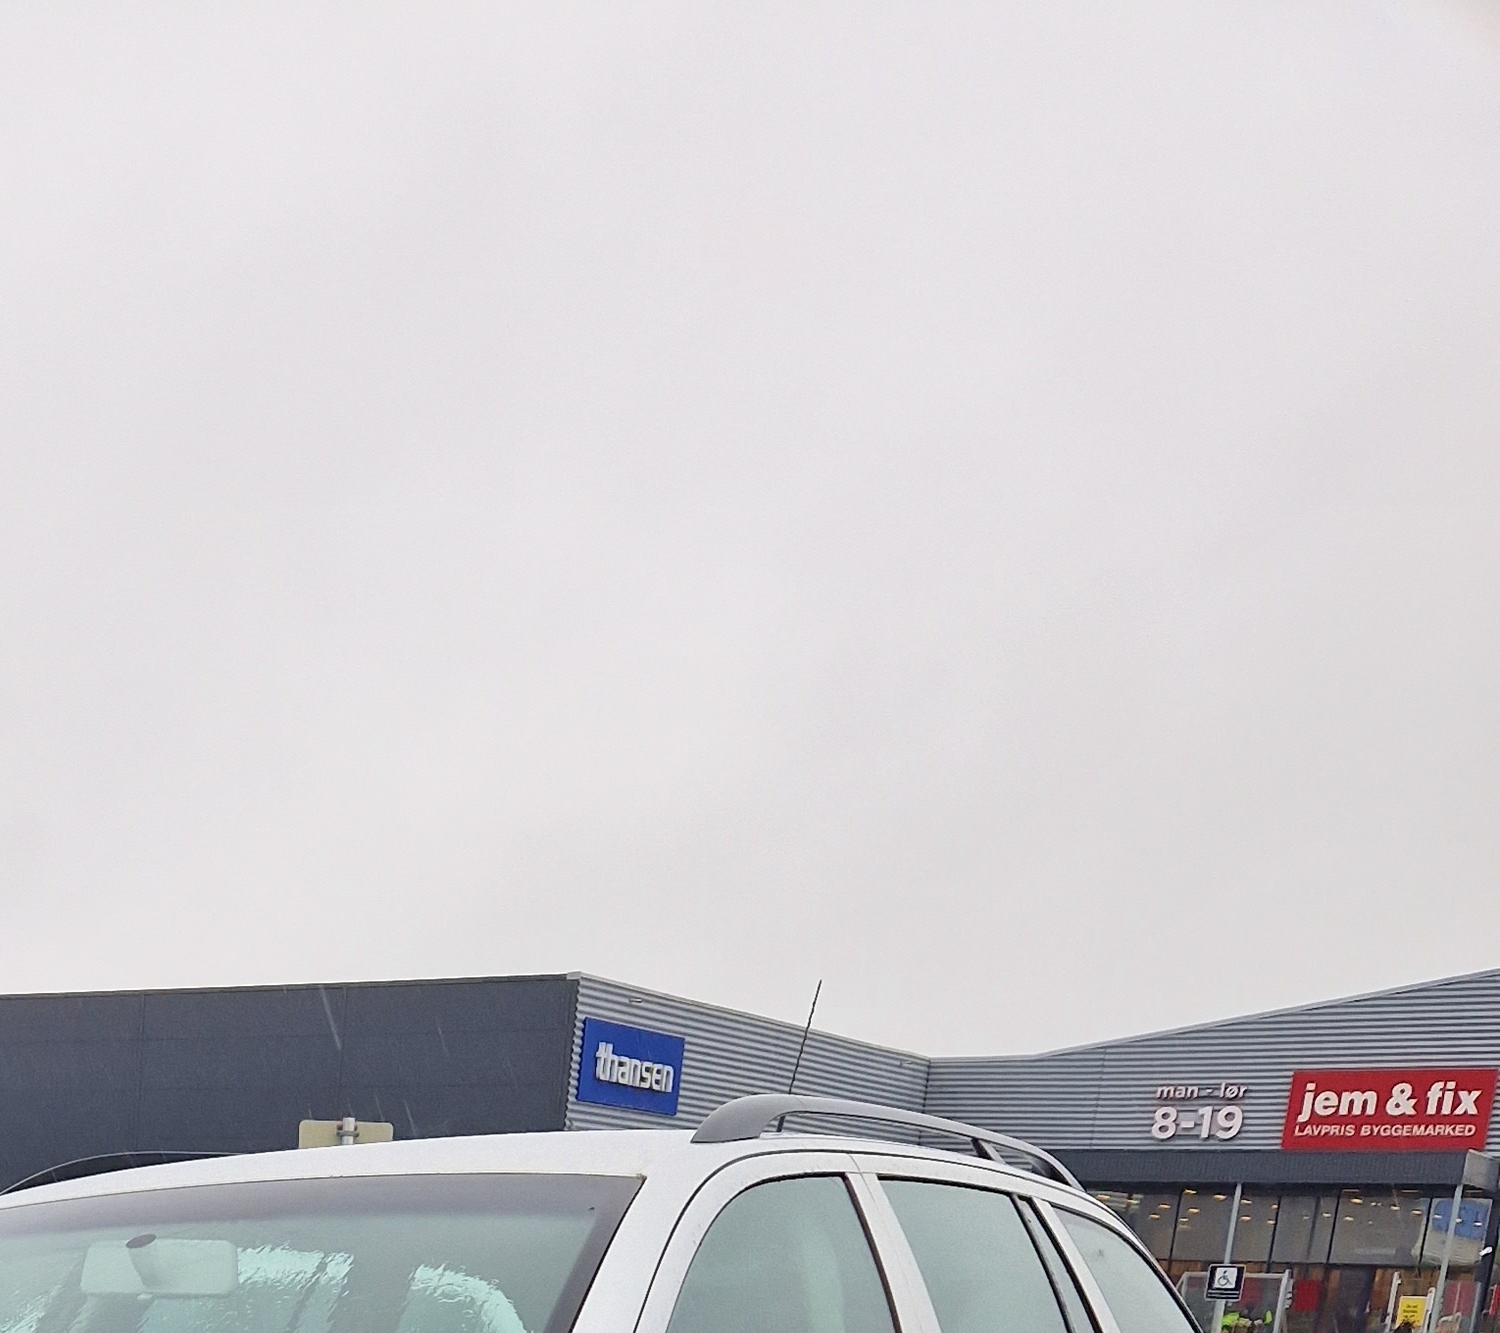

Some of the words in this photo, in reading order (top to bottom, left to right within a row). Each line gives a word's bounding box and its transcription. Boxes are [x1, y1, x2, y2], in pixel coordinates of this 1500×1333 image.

[596, 1041, 674, 1093] thansen
[1156, 1085, 1199, 1098] man
[1220, 1082, 1248, 1098] lør
[1296, 1082, 1377, 1122] jem
[1386, 1082, 1418, 1115] &
[1426, 1081, 1482, 1115] fix
[1151, 1105, 1243, 1139] 8-19
[1294, 1124, 1355, 1136] LAVPRIS
[1360, 1124, 1476, 1136] BYGGEMARKED
